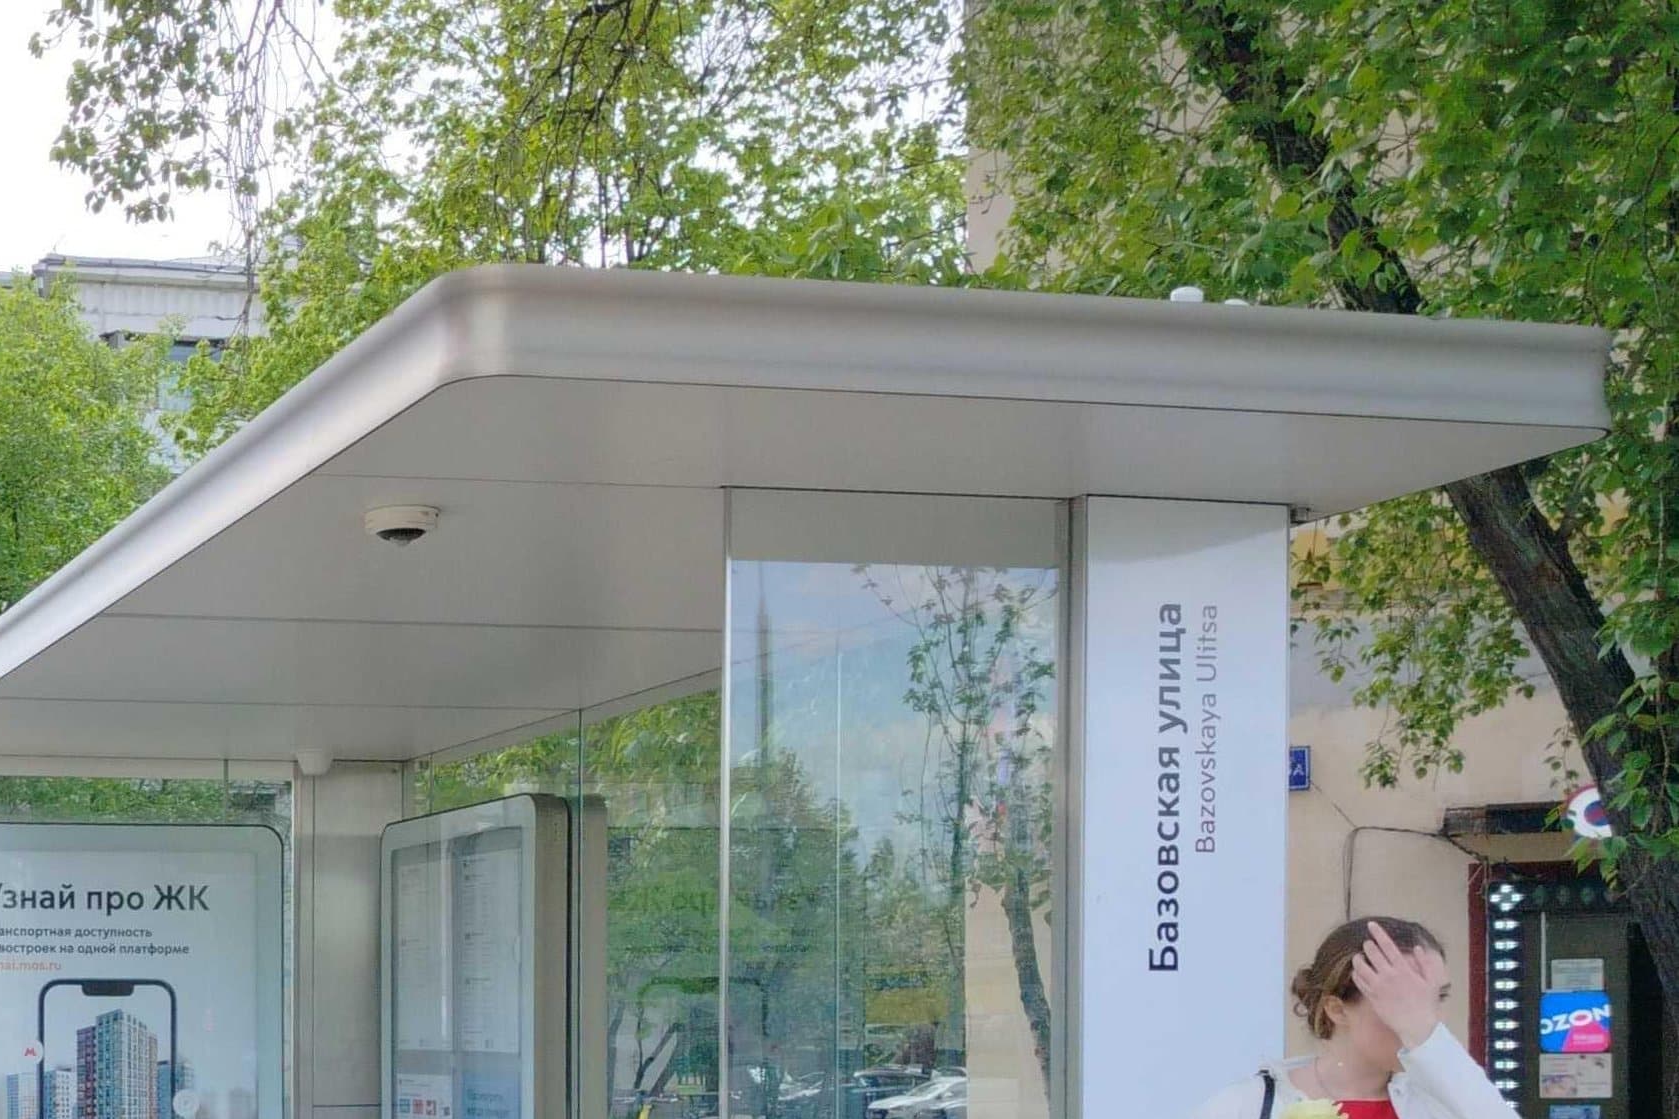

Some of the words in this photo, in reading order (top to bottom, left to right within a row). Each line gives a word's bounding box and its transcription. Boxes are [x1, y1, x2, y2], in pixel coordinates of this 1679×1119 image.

[1157, 602, 1188, 733] улица
[1195, 604, 1218, 682] Ulitsa
[1194, 692, 1222, 853] Bazovskaya
[1149, 746, 1182, 971] Базовская
[86, 890, 144, 917] про
[152, 884, 210, 911] ЖК
[59, 945, 74, 954] на
[77, 942, 116, 955] одной
[120, 943, 190, 956] платформе
[74, 927, 153, 940] доступность
[1539, 1003, 1612, 1035] OZON
